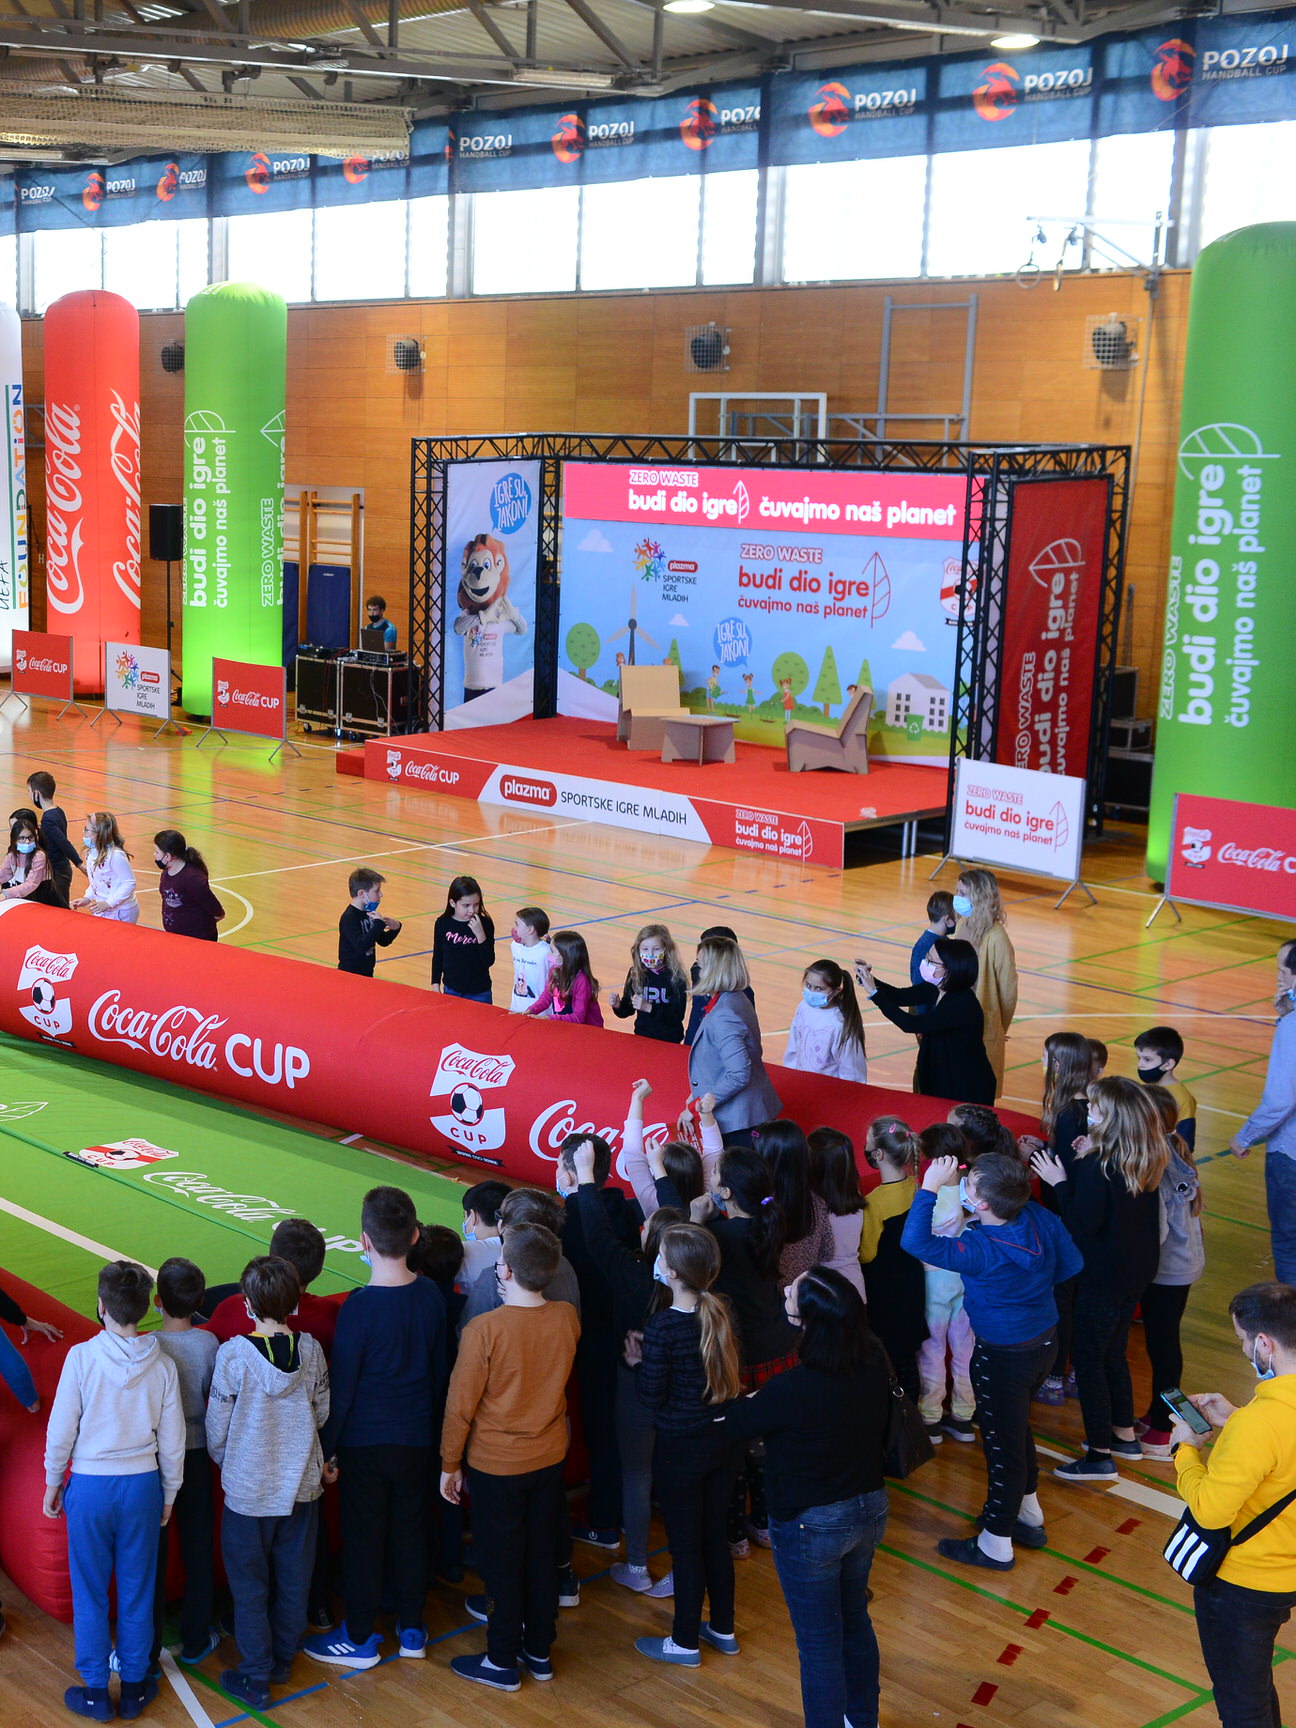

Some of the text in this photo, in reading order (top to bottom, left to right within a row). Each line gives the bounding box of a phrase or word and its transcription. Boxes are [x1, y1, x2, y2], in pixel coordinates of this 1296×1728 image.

[1203, 44, 1288, 70] POZOJ
[1024, 67, 1093, 92] POZOJ
[1202, 65, 1287, 81] HANDBALL CUP
[855, 88, 917, 111] POZOJ
[1025, 87, 1091, 101] HANDBALL CUP
[855, 107, 914, 120] HANDBALL CUP
[589, 121, 634, 139] POZOJ
[459, 134, 512, 152] POZOJ
[459, 149, 496, 159] HANDBALL
[179, 169, 207, 184] POZOJ
[273, 158, 310, 174] POZOJ
[21, 186, 55, 200] POZOJ
[106, 178, 136, 193] POZOJ
[629, 470, 699, 488] ZERO WASTE
[492, 477, 514, 507] IGRE
[497, 495, 528, 531] ZAKON!
[628, 489, 956, 528] budi dio igre čuvajmo naš planet
[189, 437, 212, 608] budi dio igre
[211, 437, 232, 608] čuvajmo naš planet
[261, 498, 274, 607] ZERO WASTE
[740, 543, 823, 565] ZERO WASTE
[663, 575, 697, 585] SPORTSKE
[738, 566, 870, 601] budi dio igre
[662, 593, 688, 603] MLADIH
[1178, 464, 1234, 726] budi dio igre
[1223, 464, 1266, 728] čuvajmo naš planet
[737, 596, 868, 620] čuvajmo naš planet
[1037, 572, 1067, 703] dio igre
[1057, 571, 1080, 688] naš planet
[52, 662, 68, 674] CUP
[137, 684, 161, 694] SPORTSKE
[1018, 651, 1036, 723] WASTE
[136, 700, 155, 709] MLADIH
[260, 696, 280, 709] CUP
[405, 760, 460, 785] Coca-Cola CUP
[504, 778, 687, 825] plazma SPORTSKE IGRE MLADIH
[966, 784, 1024, 805] ZERO WASTE
[965, 799, 1054, 832] budi dio igre
[735, 820, 802, 846] budi dio igre
[964, 819, 1053, 845] čuvajmo naš planet
[1217, 842, 1286, 872] Coca-Cola
[25, 951, 77, 978] Coca-Cola
[33, 1015, 60, 1030] CUP
[88, 989, 311, 1089] Coca-Cola CUP
[440, 1049, 511, 1085] Coca-Cola
[450, 1126, 487, 1145] CUP
[86, 1153, 115, 1167] CUP
[143, 1171, 304, 1223] Coca-Cola
